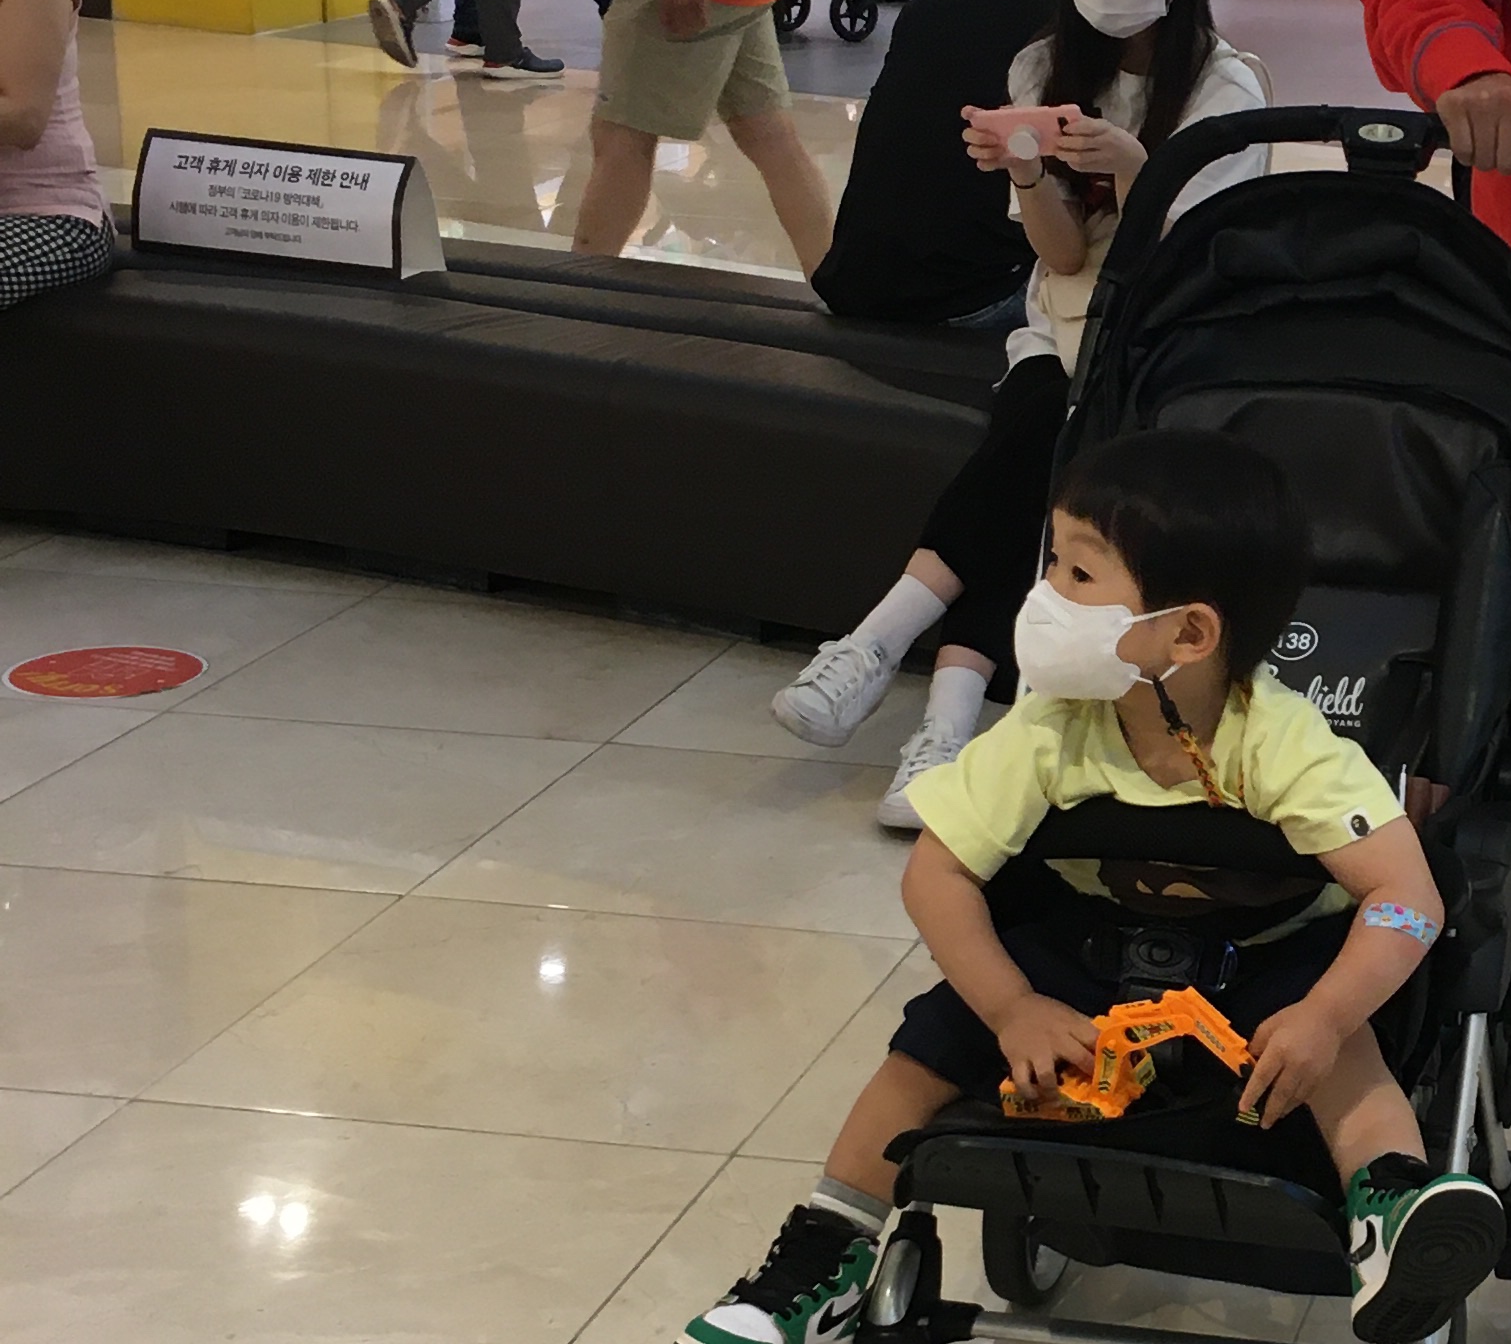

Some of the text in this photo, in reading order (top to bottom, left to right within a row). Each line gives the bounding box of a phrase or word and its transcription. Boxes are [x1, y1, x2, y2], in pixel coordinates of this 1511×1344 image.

[173, 154, 371, 191] 고객 휴게 의자 이용 제한 안내
